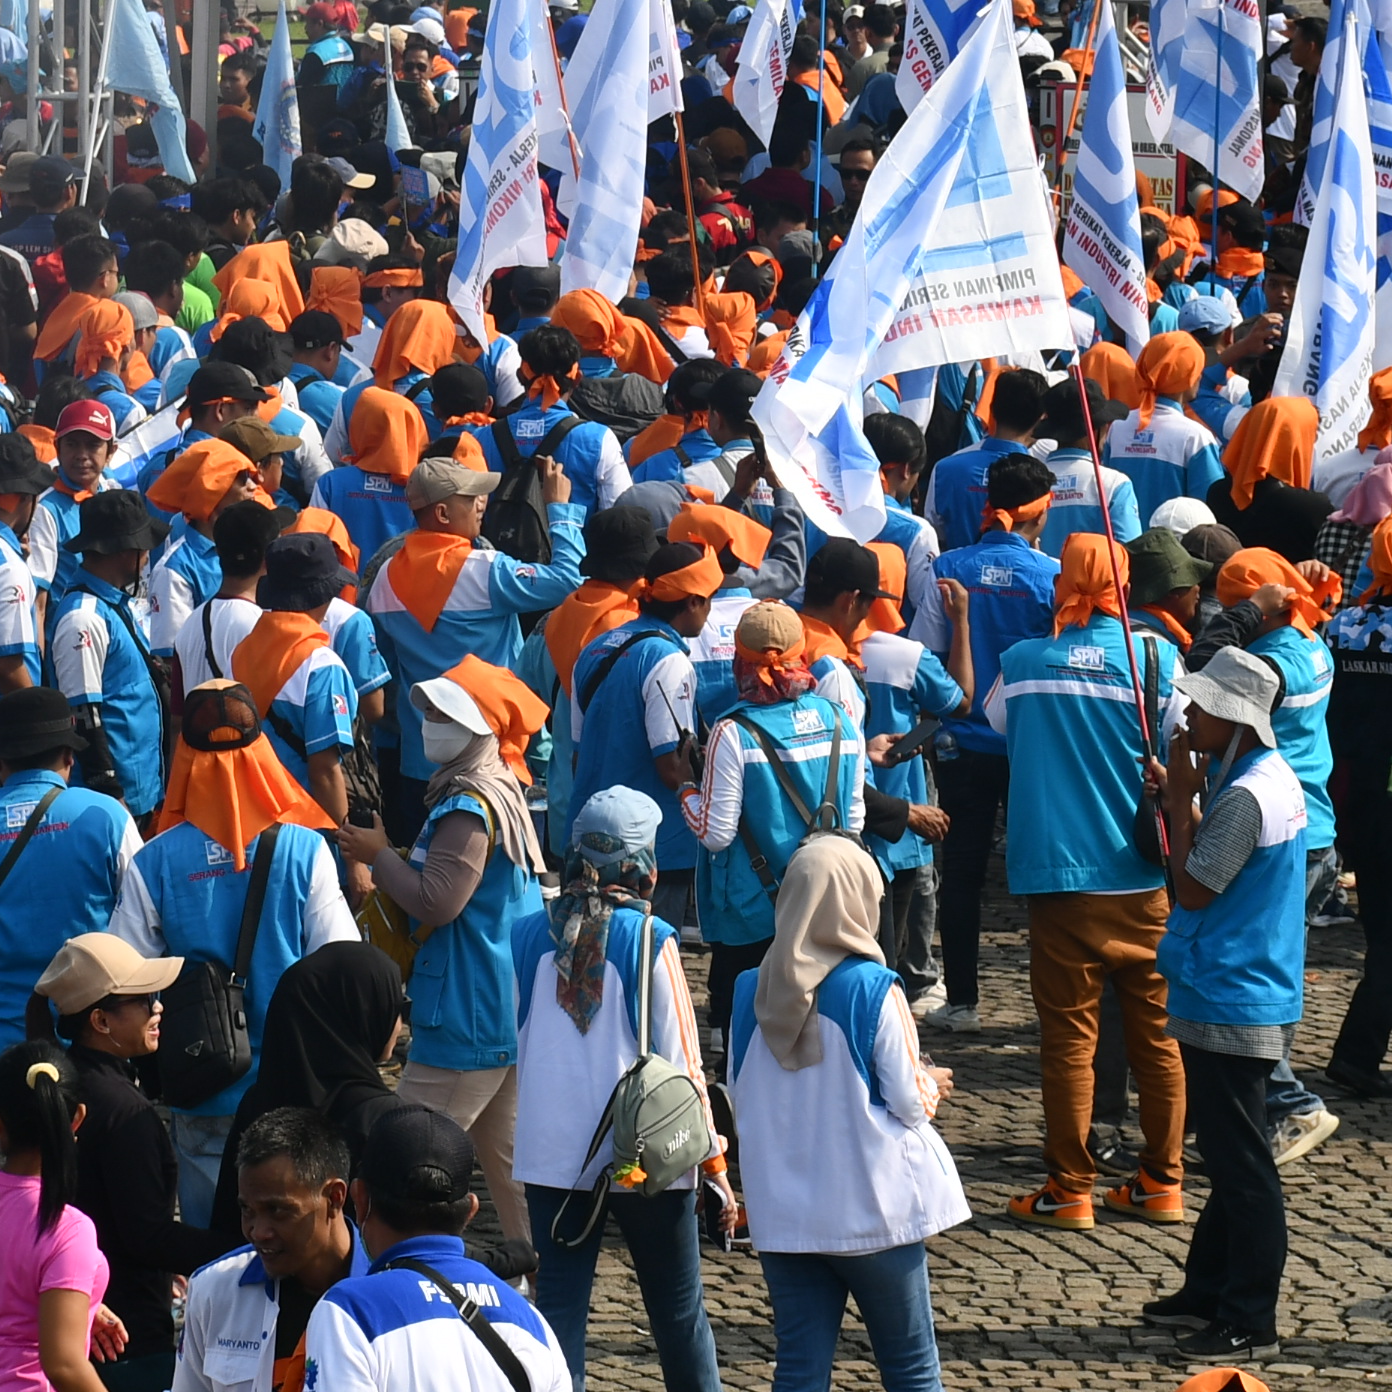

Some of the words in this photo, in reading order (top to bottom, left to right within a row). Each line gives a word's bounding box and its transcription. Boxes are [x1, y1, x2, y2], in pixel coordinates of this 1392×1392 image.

[1072, 201, 1104, 238] SERIKAT
[1101, 229, 1130, 271] PEKERJA
[1075, 228, 1121, 287] INDUSTRI
[515, 418, 545, 437] SPN
[365, 474, 392, 492] SPN
[981, 566, 1013, 585] SPN
[1069, 645, 1104, 666] SPN
[1342, 660, 1379, 674] LASKAR
[187, 868, 225, 882] SERANG
[217, 1336, 260, 1351] MARYANTO
